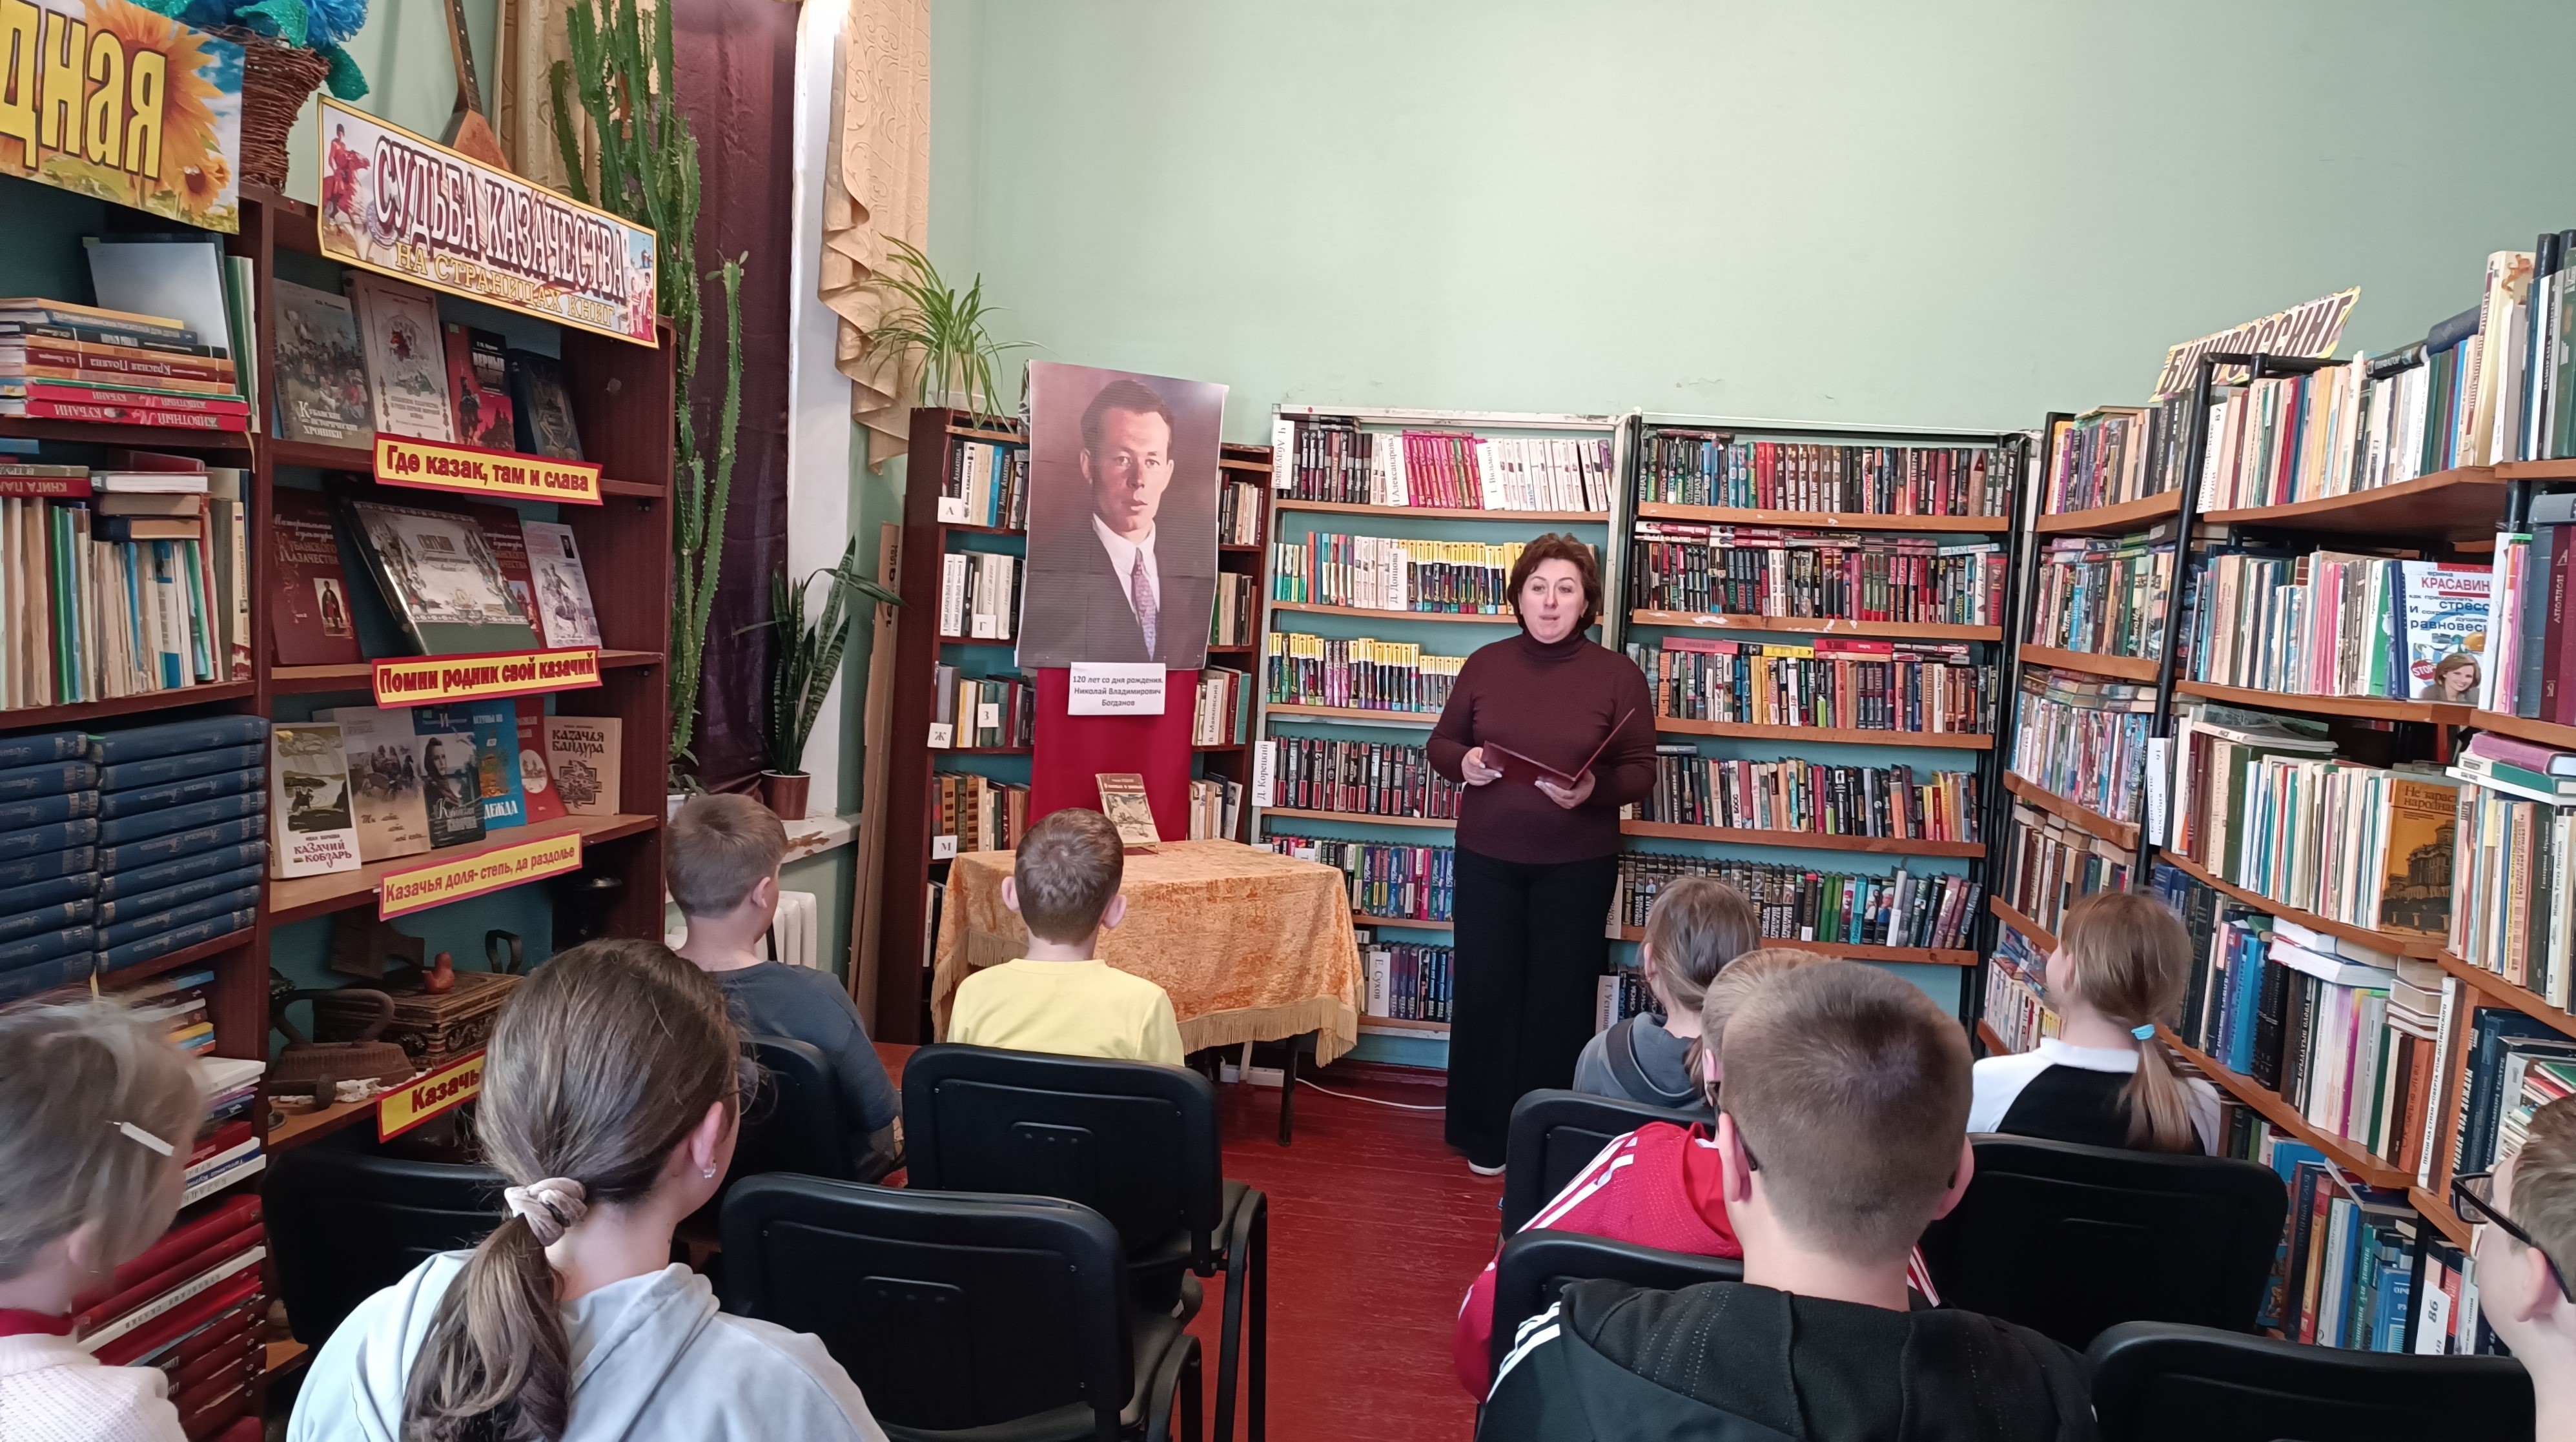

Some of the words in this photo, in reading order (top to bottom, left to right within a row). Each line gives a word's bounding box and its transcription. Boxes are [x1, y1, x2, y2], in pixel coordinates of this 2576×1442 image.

[373, 136, 481, 256] СУДЬБА
[483, 179, 628, 303] КАЗАЧЕСТВА
[396, 242, 428, 276] НА
[434, 254, 563, 318] СТРАНИЦАХ
[567, 294, 615, 327] КНИГ
[131, 361, 171, 375] Красная
[55, 404, 101, 418] КУБАНИ
[158, 412, 218, 427] ЖИВОТНЫЙ
[387, 445, 420, 475] Где
[425, 454, 488, 485] казак,
[492, 464, 525, 485] там
[529, 470, 540, 486] и
[544, 471, 589, 491] слава
[26, 481, 67, 493] КНИГА
[946, 506, 954, 515] А
[979, 622, 986, 631] Г
[379, 667, 439, 693] Помни
[443, 665, 500, 693] родник
[502, 656, 537, 682] свой
[538, 652, 594, 678] казачий
[2412, 664, 2433, 676] STOP
[552, 729, 606, 744] КАЗАЧЬЯ
[935, 731, 946, 741] Ж
[552, 740, 606, 759] БАНДУРА
[1258, 744, 1269, 786] Корецкий
[2404, 785, 2420, 797] Не
[294, 839, 345, 855] КАЗАЧИЙ
[941, 842, 951, 851] М
[305, 851, 353, 868] КОБЗАРЬ
[385, 880, 442, 903] Казачья
[445, 868, 478, 891] доля-
[480, 860, 513, 880] степь,
[515, 857, 528, 873] да
[531, 846, 575, 871] раздолье
[1374, 971, 1384, 999] Сухов
[2297, 1030, 2309, 1078] КРЫЛАТЫЕ
[2426, 1130, 2431, 1140] НА
[2430, 1075, 2439, 1105] РОБЕРТА
[2435, 1004, 2447, 1073] РОЖДЕСТВЕНСКОГО
[2428, 1299, 2439, 1323] 86
